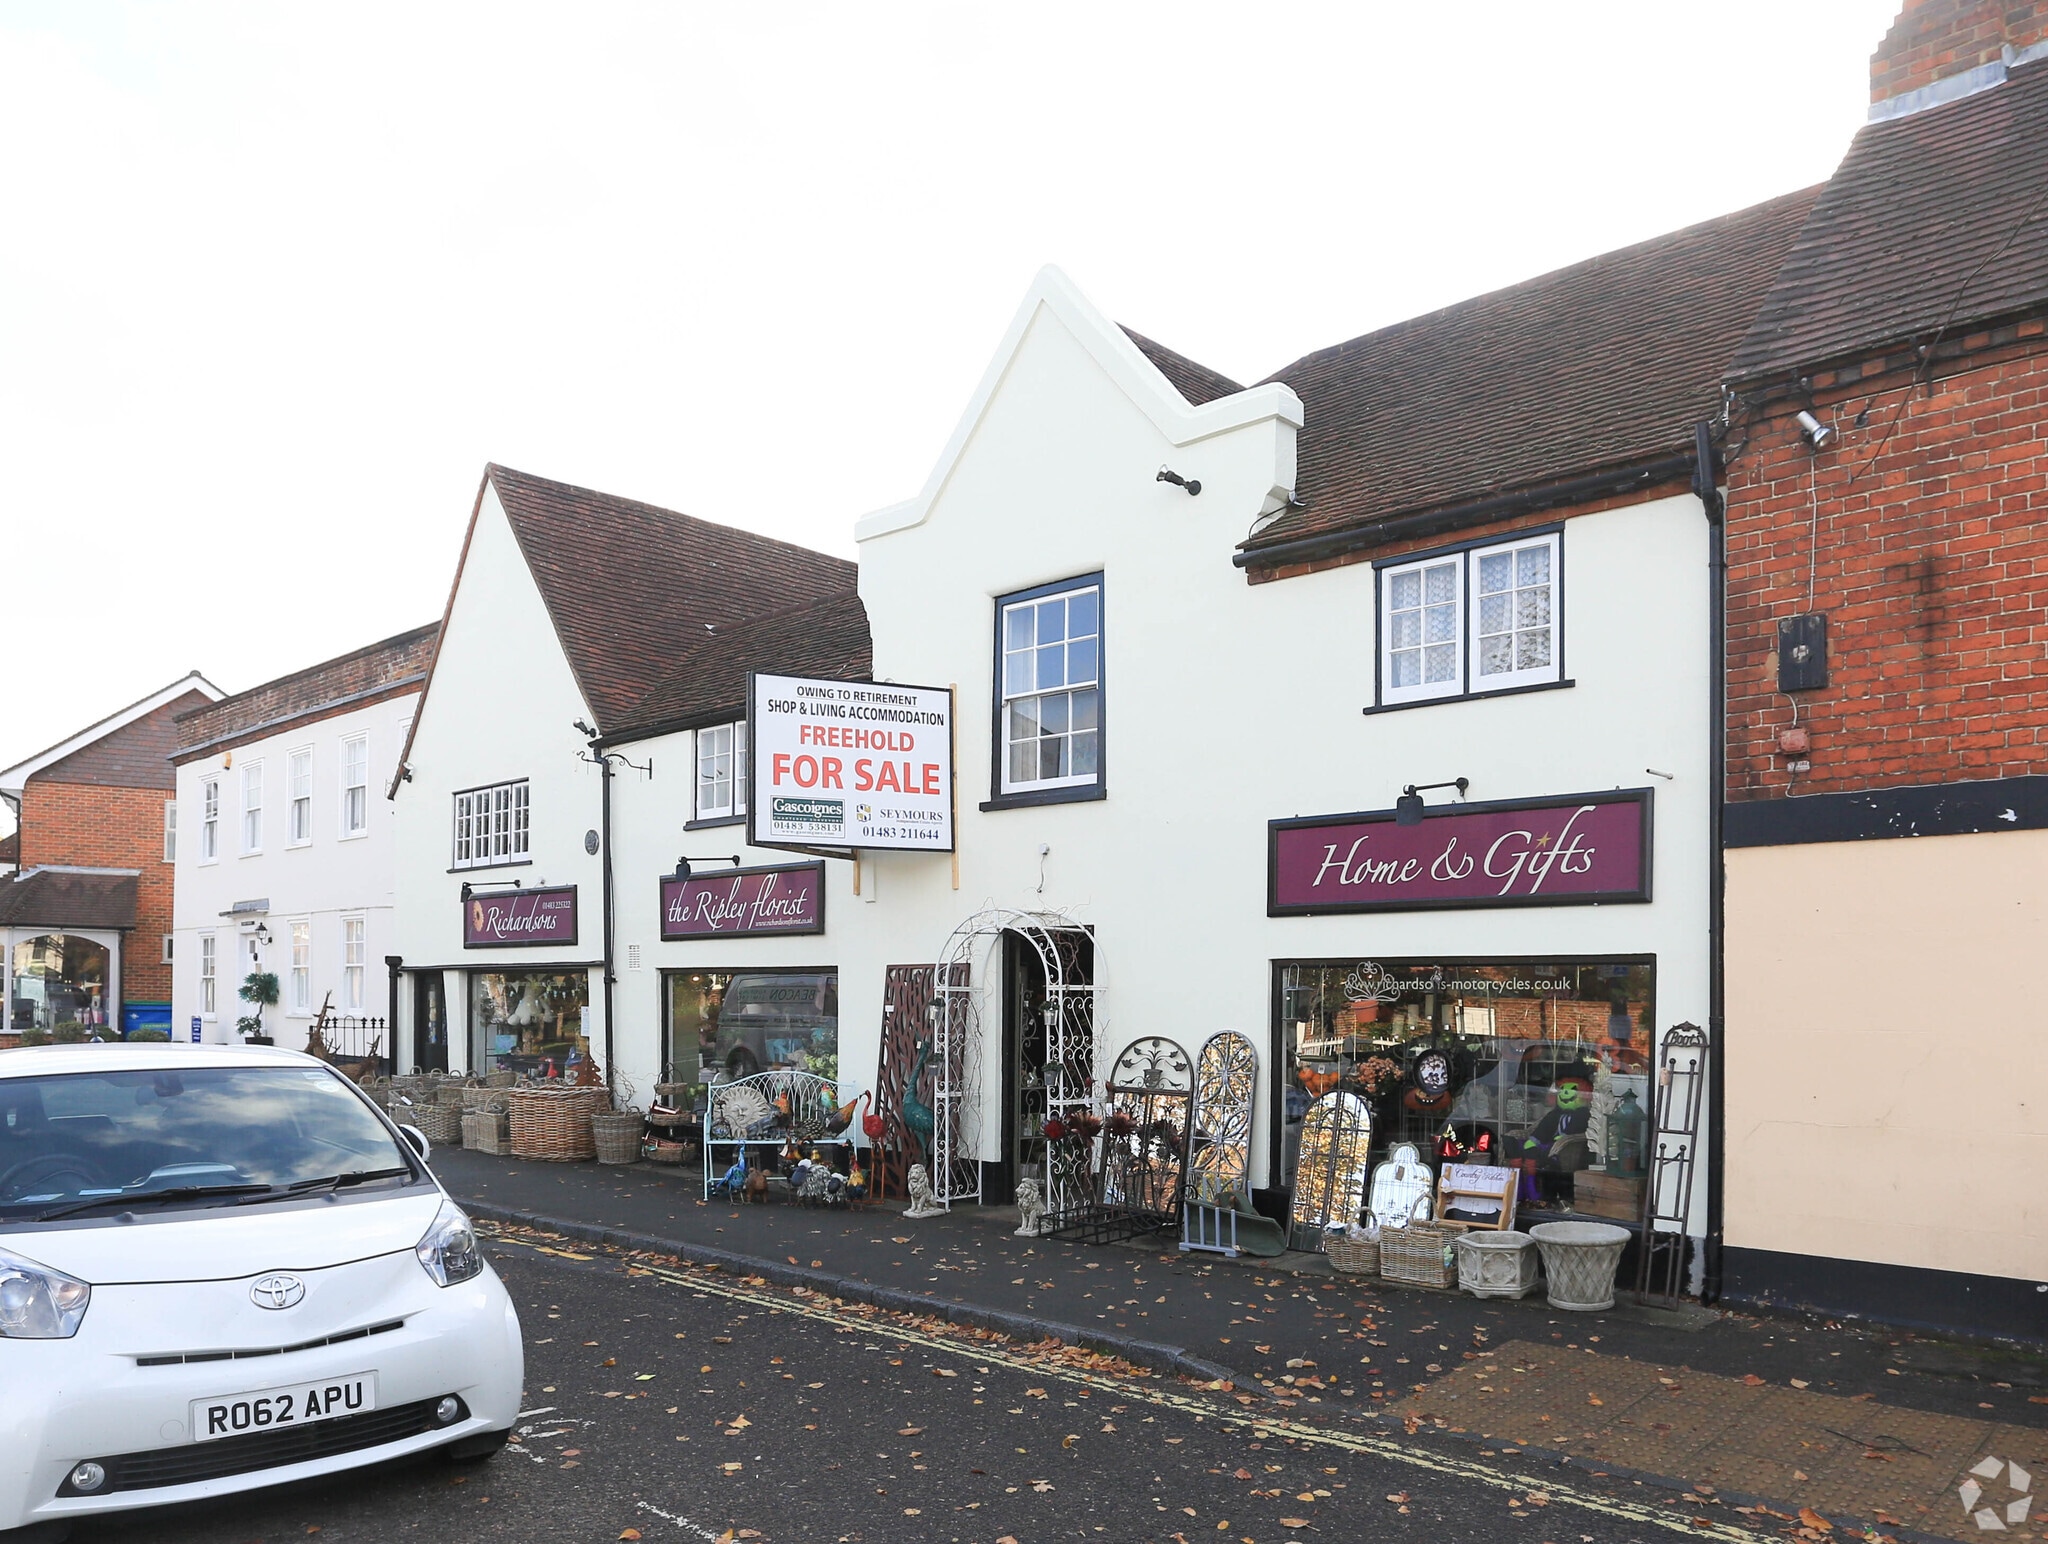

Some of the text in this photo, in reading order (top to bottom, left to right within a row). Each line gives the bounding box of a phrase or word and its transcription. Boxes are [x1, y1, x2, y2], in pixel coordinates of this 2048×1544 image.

[796, 686, 918, 706] OWING TO RETIREMENT
[768, 699, 944, 726] SHOP & LIVING ACCOMMODATION
[800, 725, 915, 752] FREEHOLD
[772, 753, 940, 795] FOR SALE
[773, 798, 842, 818] Gascoignes
[880, 808, 943, 821] SEYMOURS
[773, 821, 842, 832] 01483 538131
[862, 825, 939, 840] 01483 211644
[1312, 805, 1597, 896] Home & Gifts
[668, 873, 808, 931] the Ripley florist
[486, 894, 557, 939] Richardsons
[208, 1381, 362, 1435] RO62 APU
